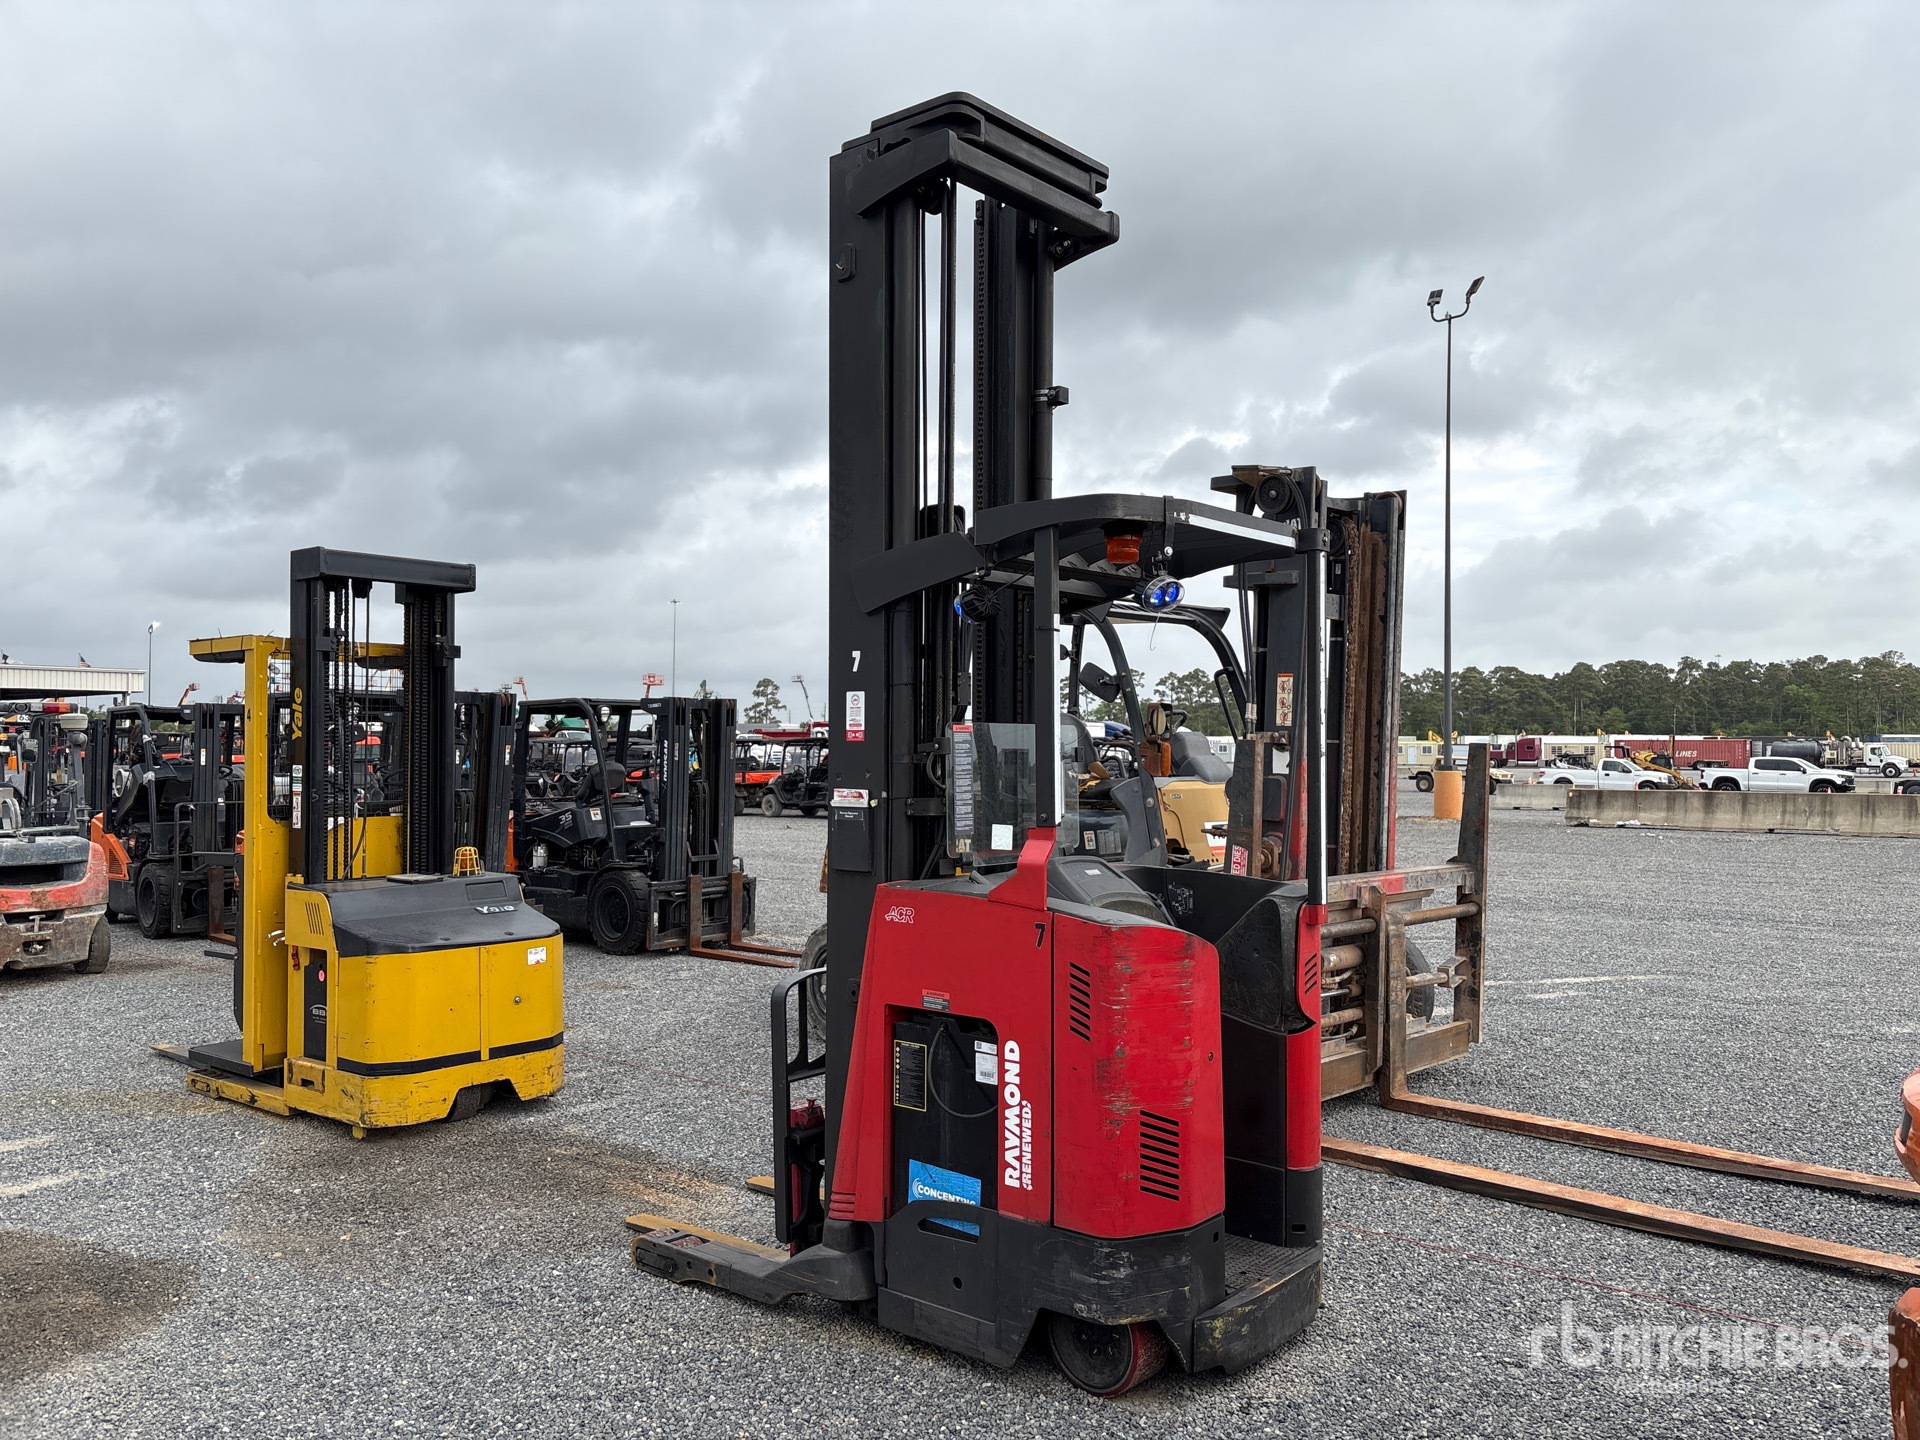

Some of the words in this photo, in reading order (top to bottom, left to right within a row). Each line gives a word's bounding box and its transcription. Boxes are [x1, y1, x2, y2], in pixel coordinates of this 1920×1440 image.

[852, 650, 861, 672] 7
[246, 707, 252, 722] 4
[292, 687, 302, 740] Yale
[1675, 750, 1698, 758] LINES
[559, 811, 573, 825] 35
[476, 905, 516, 914] Yale
[885, 905, 915, 924] ACR
[1034, 921, 1047, 949] 7
[1004, 1040, 1021, 1189] RAYMOND
[1021, 1108, 1032, 1185] RENEWED
